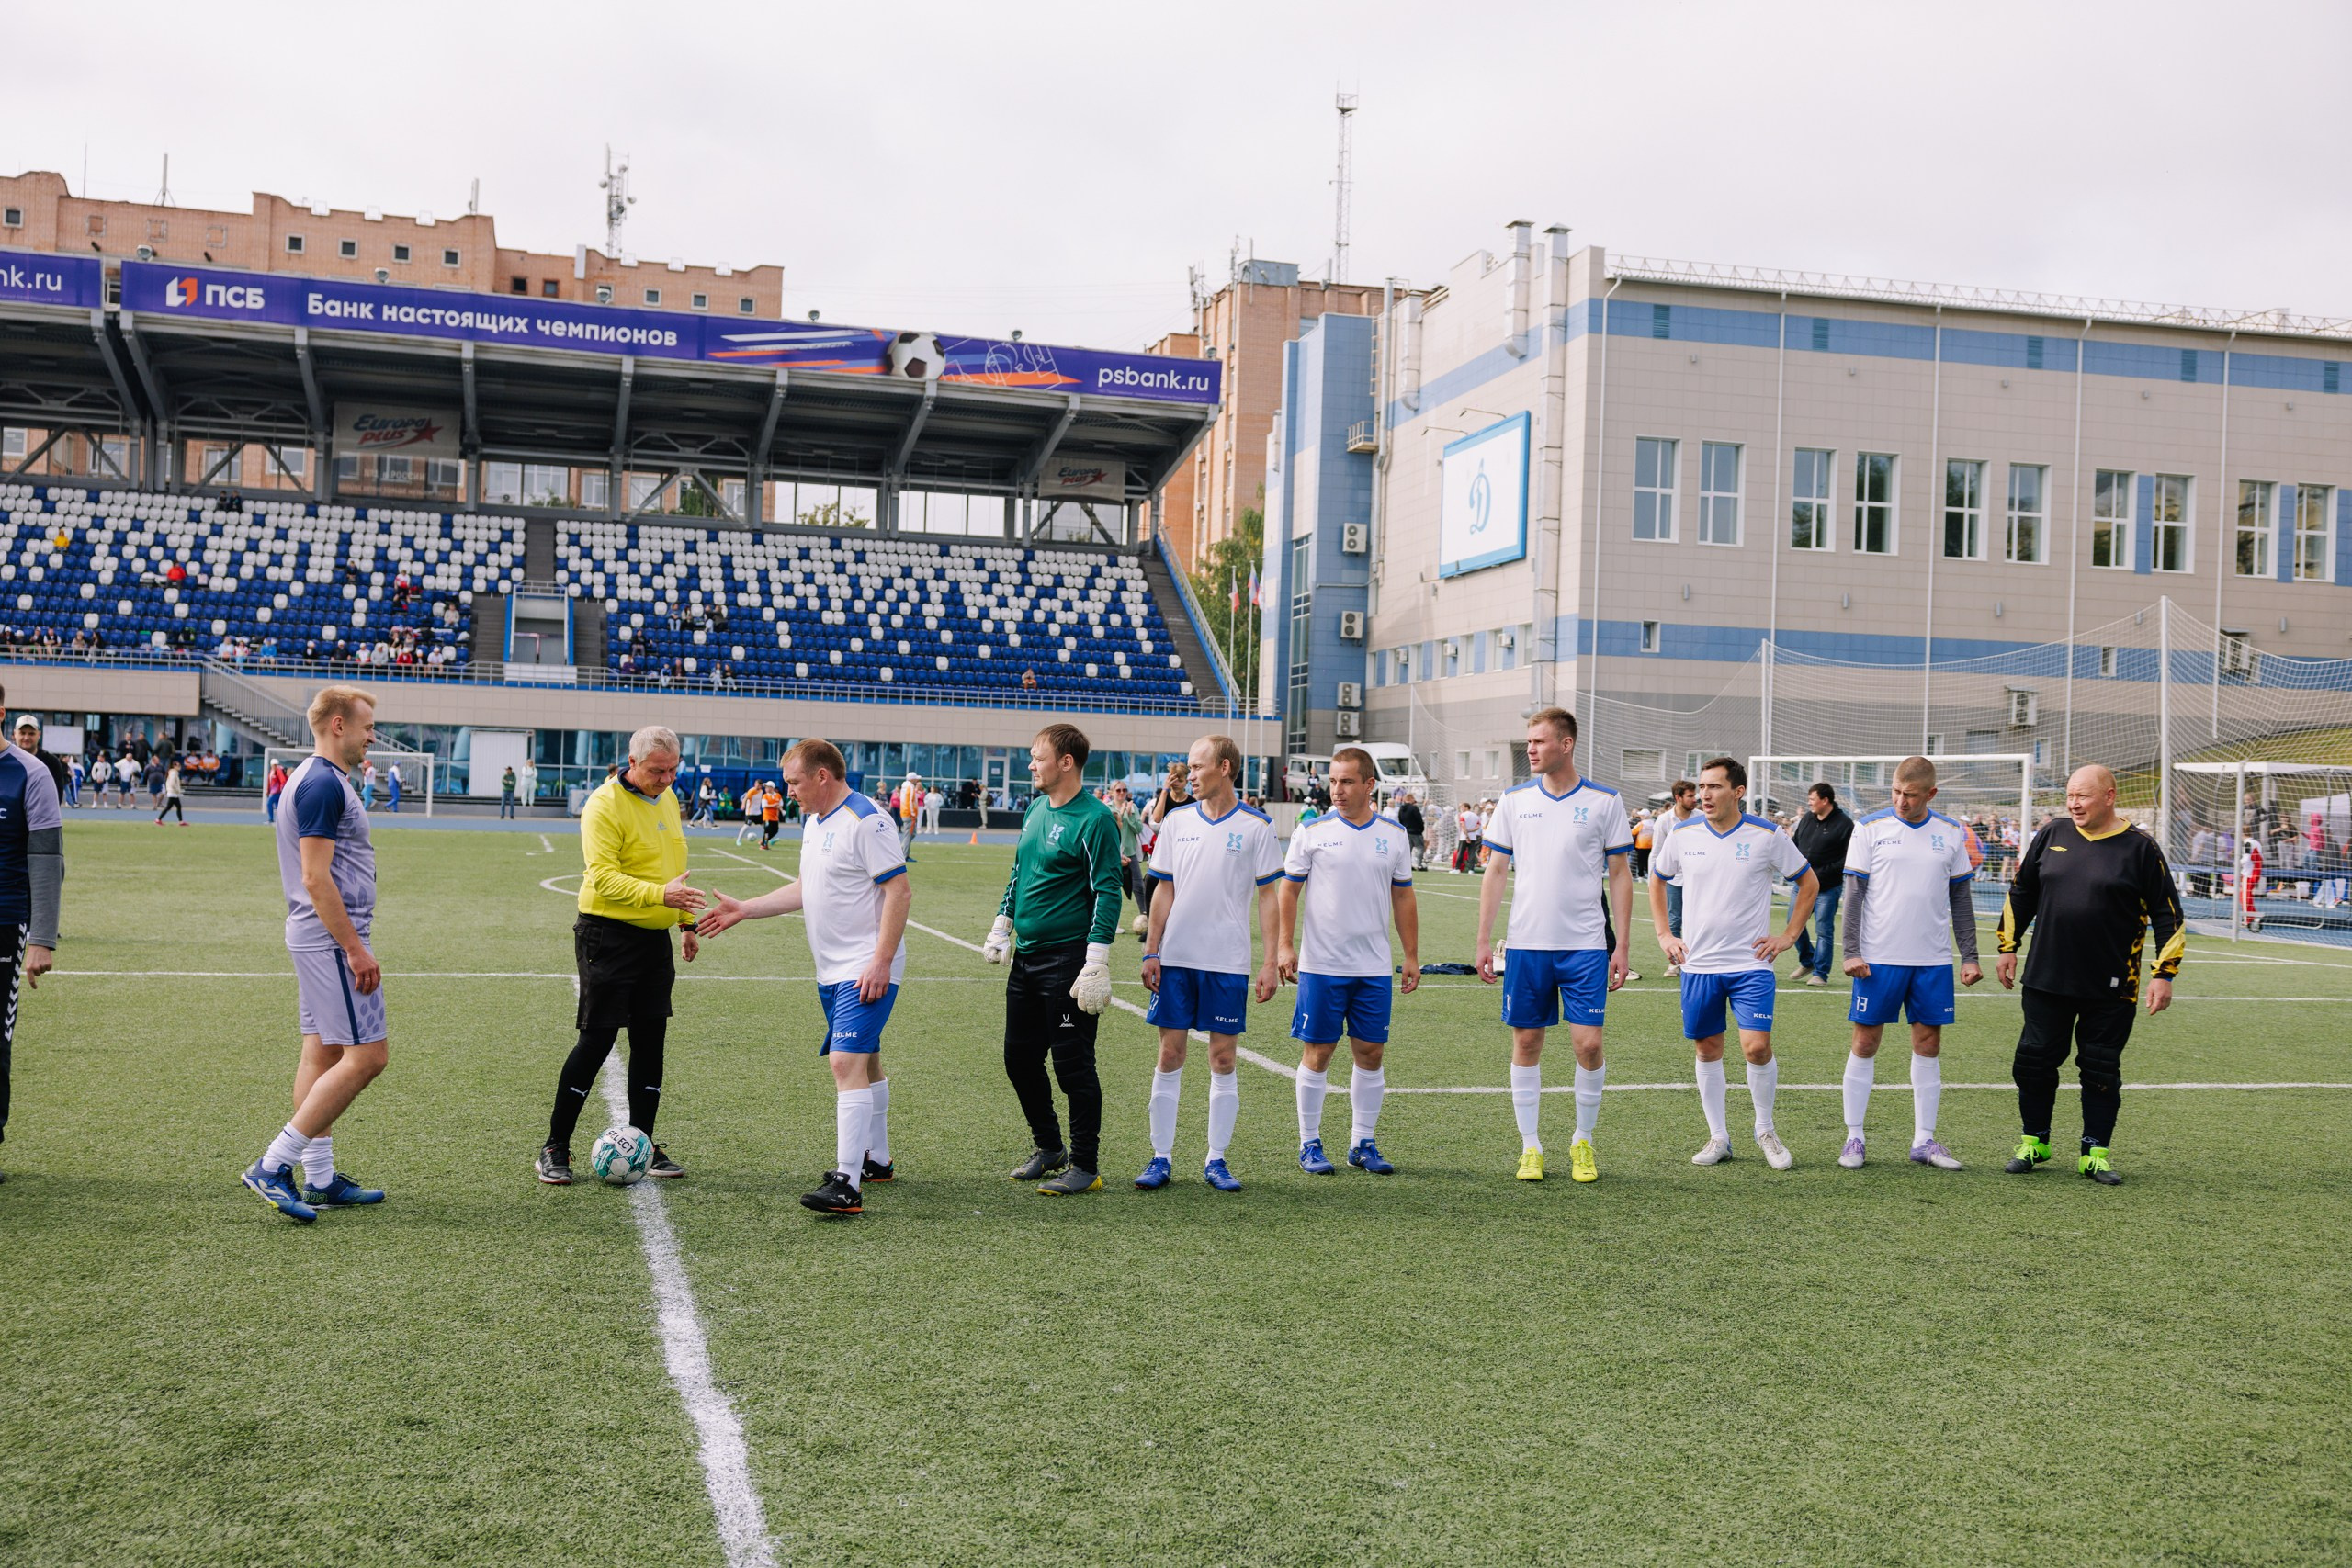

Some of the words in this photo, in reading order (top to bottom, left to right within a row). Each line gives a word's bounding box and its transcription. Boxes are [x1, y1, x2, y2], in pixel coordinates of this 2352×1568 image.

[205, 283, 266, 310] ПСБ
[307, 292, 374, 320] Банк
[382, 303, 529, 334] настоящих
[537, 319, 677, 347] чемпионов
[1097, 366, 1209, 391] psbank.ru
[1856, 996, 1869, 1012] 13
[1215, 1015, 1238, 1023] KELME
[1302, 1013, 1309, 1029] 7
[605, 1130, 634, 1153] SELECT
